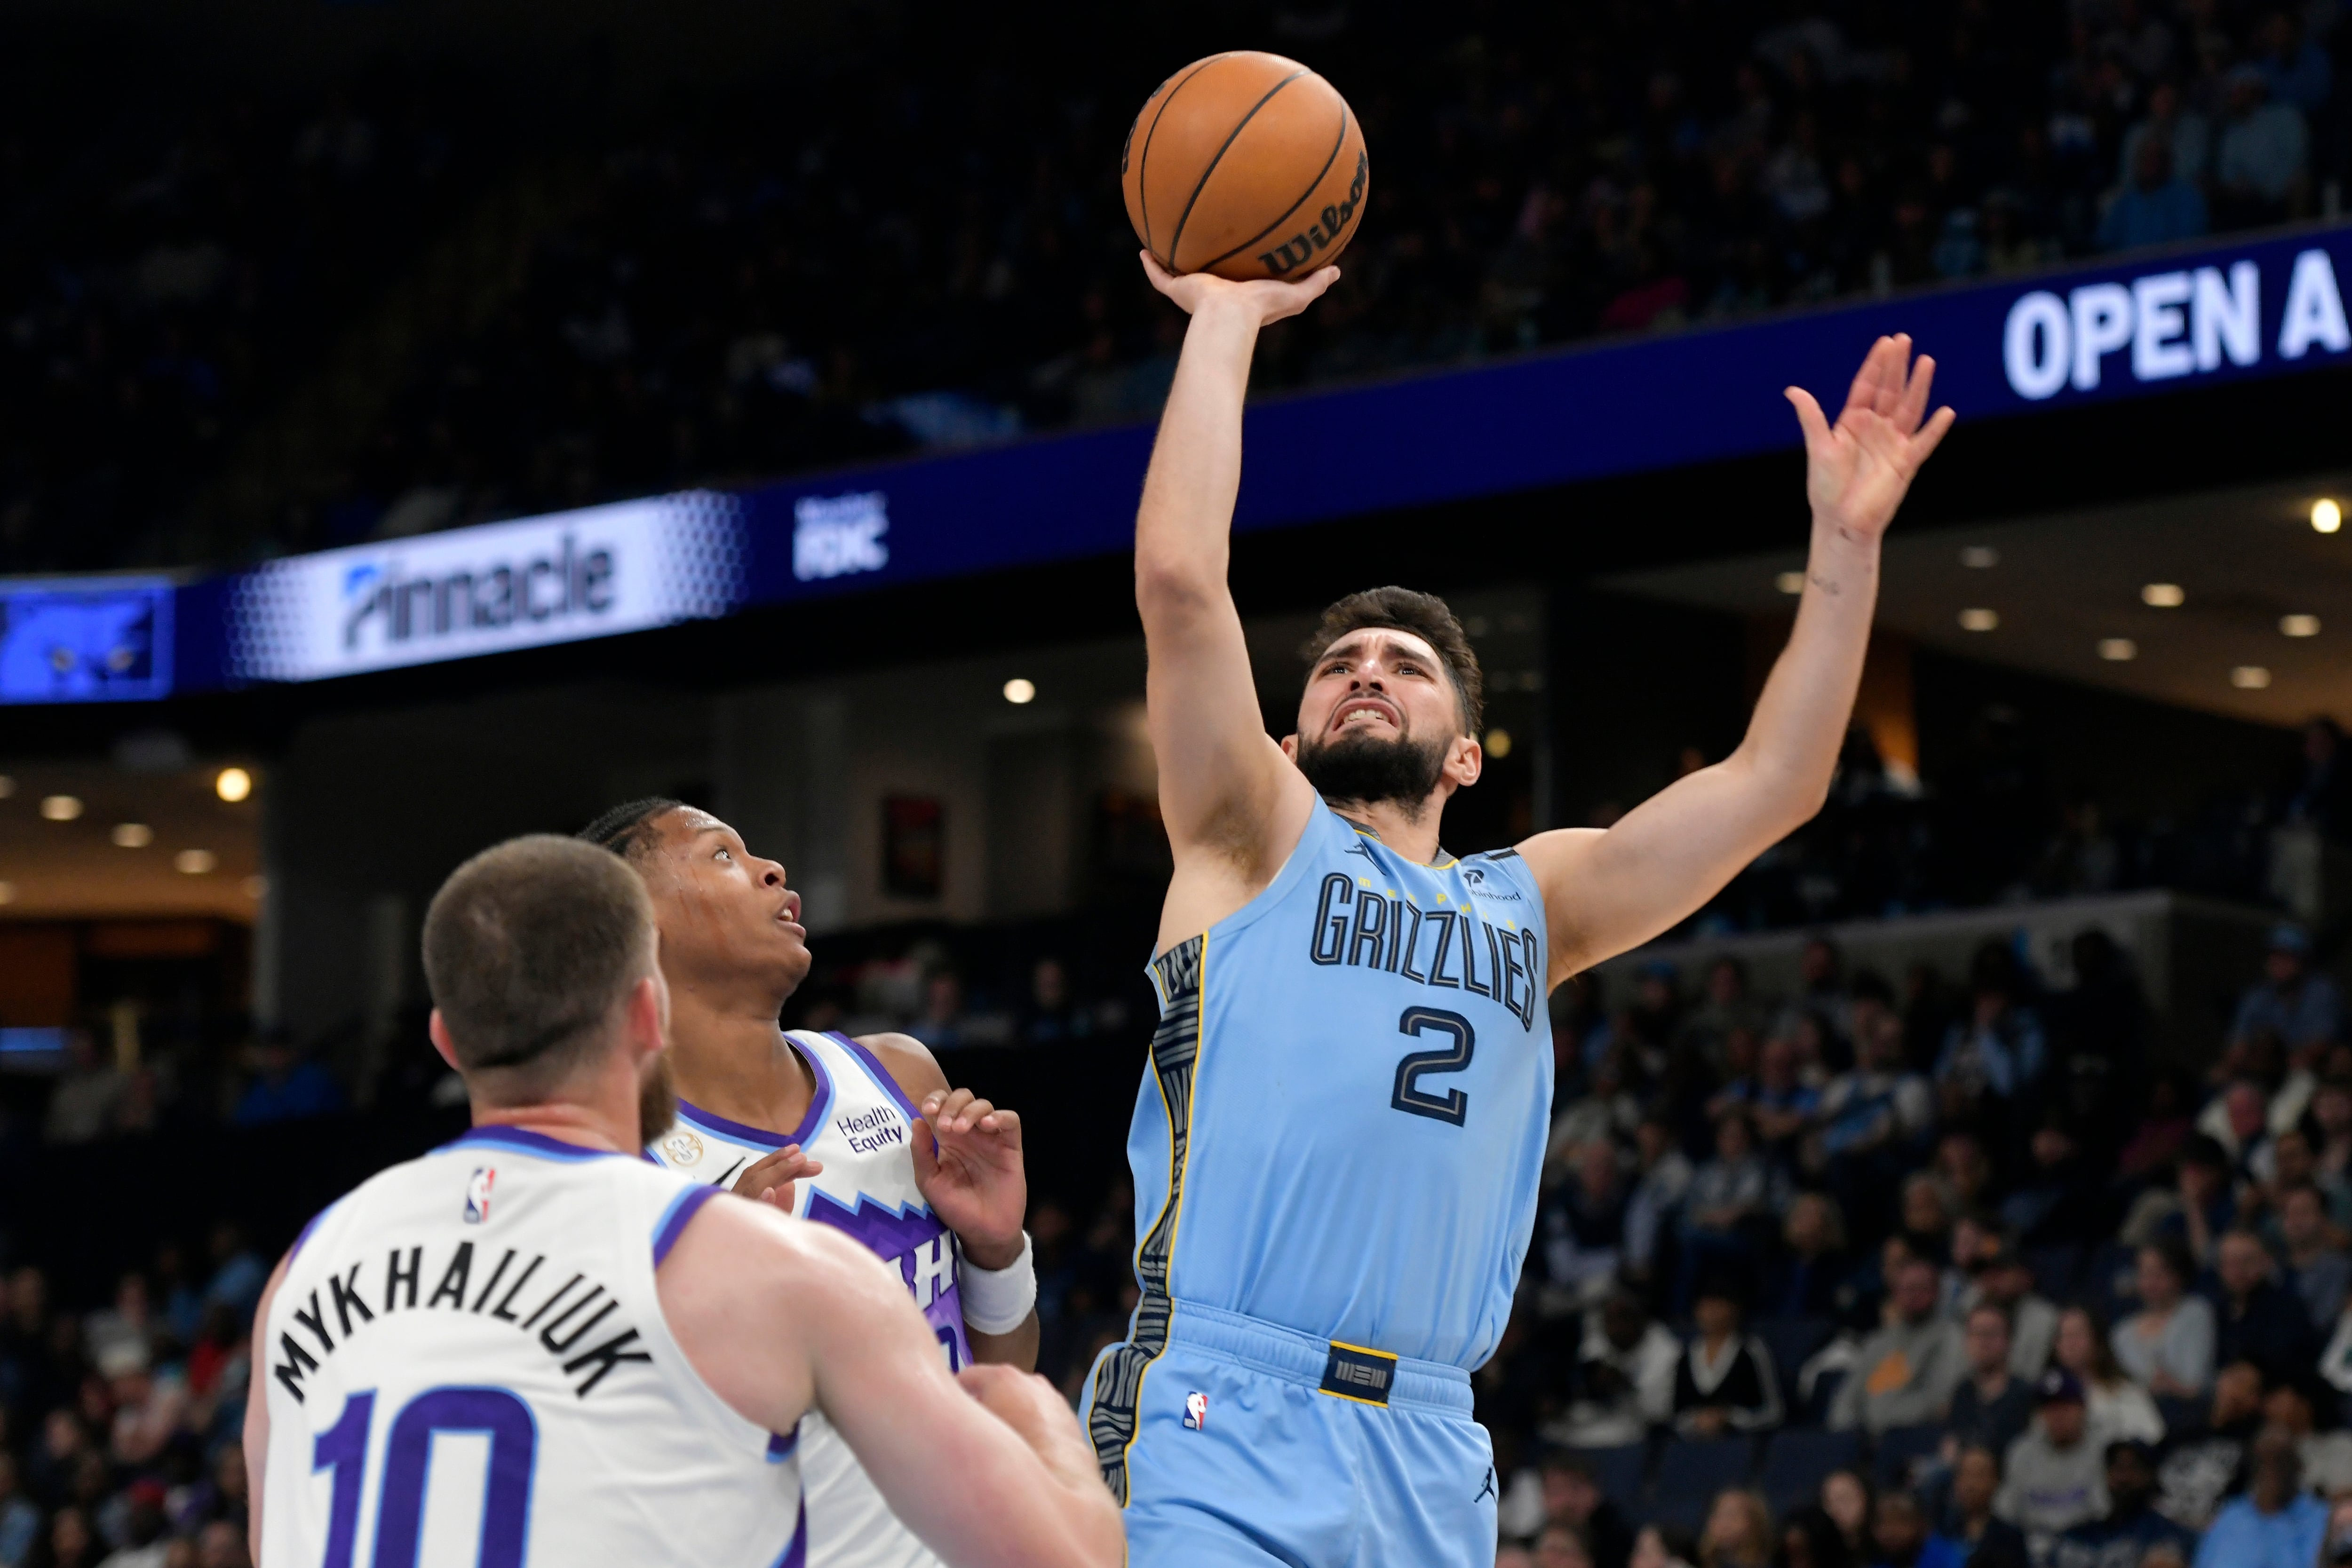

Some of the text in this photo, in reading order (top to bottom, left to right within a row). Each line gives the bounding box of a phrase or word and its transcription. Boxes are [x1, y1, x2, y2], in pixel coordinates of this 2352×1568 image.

[2002, 248, 2352, 400] OPEN A
[1310, 872, 1537, 1033] GRIZZLIES
[837, 1105, 896, 1136] Health
[848, 1125, 903, 1154] Equity
[1391, 1006, 1475, 1128] 2
[274, 1242, 653, 1404] MYKHAILIUK
[310, 1384, 540, 1568] 10
